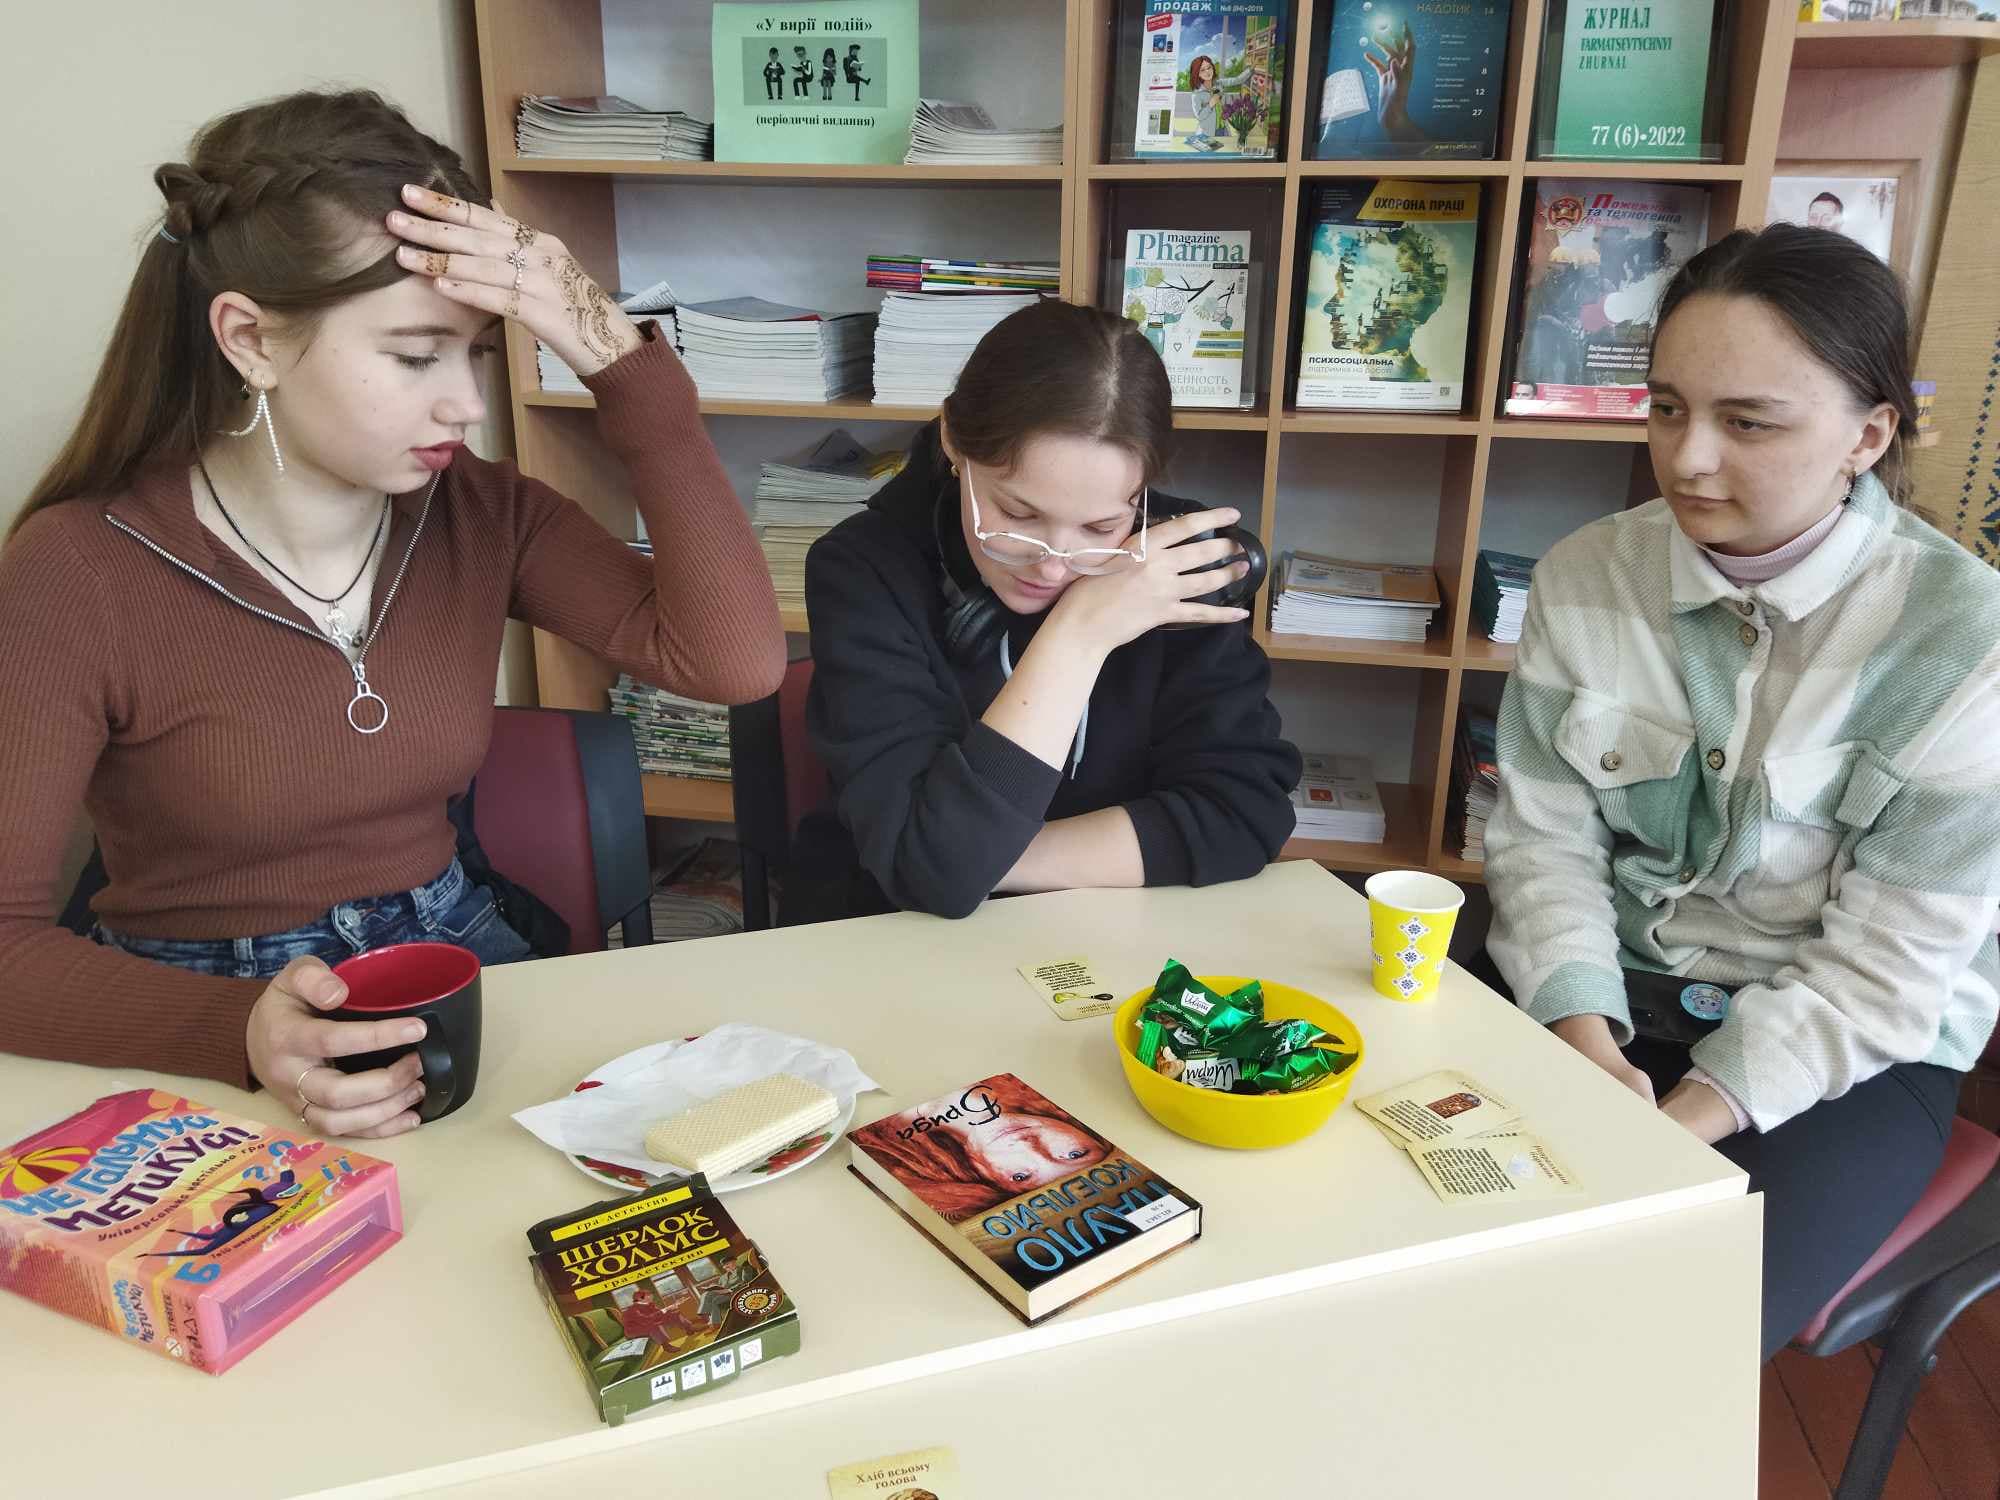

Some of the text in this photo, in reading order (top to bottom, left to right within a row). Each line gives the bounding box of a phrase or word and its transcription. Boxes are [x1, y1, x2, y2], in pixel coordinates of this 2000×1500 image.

[1153, 1, 1212, 13] продаж
[756, 18, 872, 34] «У вирії подій»
[1584, 7, 1651, 29] ЖУРНАЛ
[1579, 56, 1627, 70] ZHURNAL
[756, 114, 875, 128] (періодичні видання)
[1592, 125, 1610, 146] 77
[1373, 197, 1464, 211] ОХОРОНА ПРАЦІ
[1136, 232, 1244, 262] Pharma
[1167, 232, 1220, 245] magazine
[1309, 357, 1394, 367] ПСИХОСОЦІАЛЬНА
[1169, 374, 1228, 385] ВЕННОСТЬ
[896, 1085, 1001, 1142] Брида
[2, 1185, 87, 1217] НЕ
[98, 1143, 265, 1241] Універсальна настільна гра
[982, 1159, 1144, 1240] КОЕЛЬЙО
[557, 1207, 710, 1268] ШЕРЛОК
[566, 1220, 720, 1286] ХОЛМС
[856, 1463, 930, 1484] Хліб всьому
[875, 1475, 917, 1489] голова
